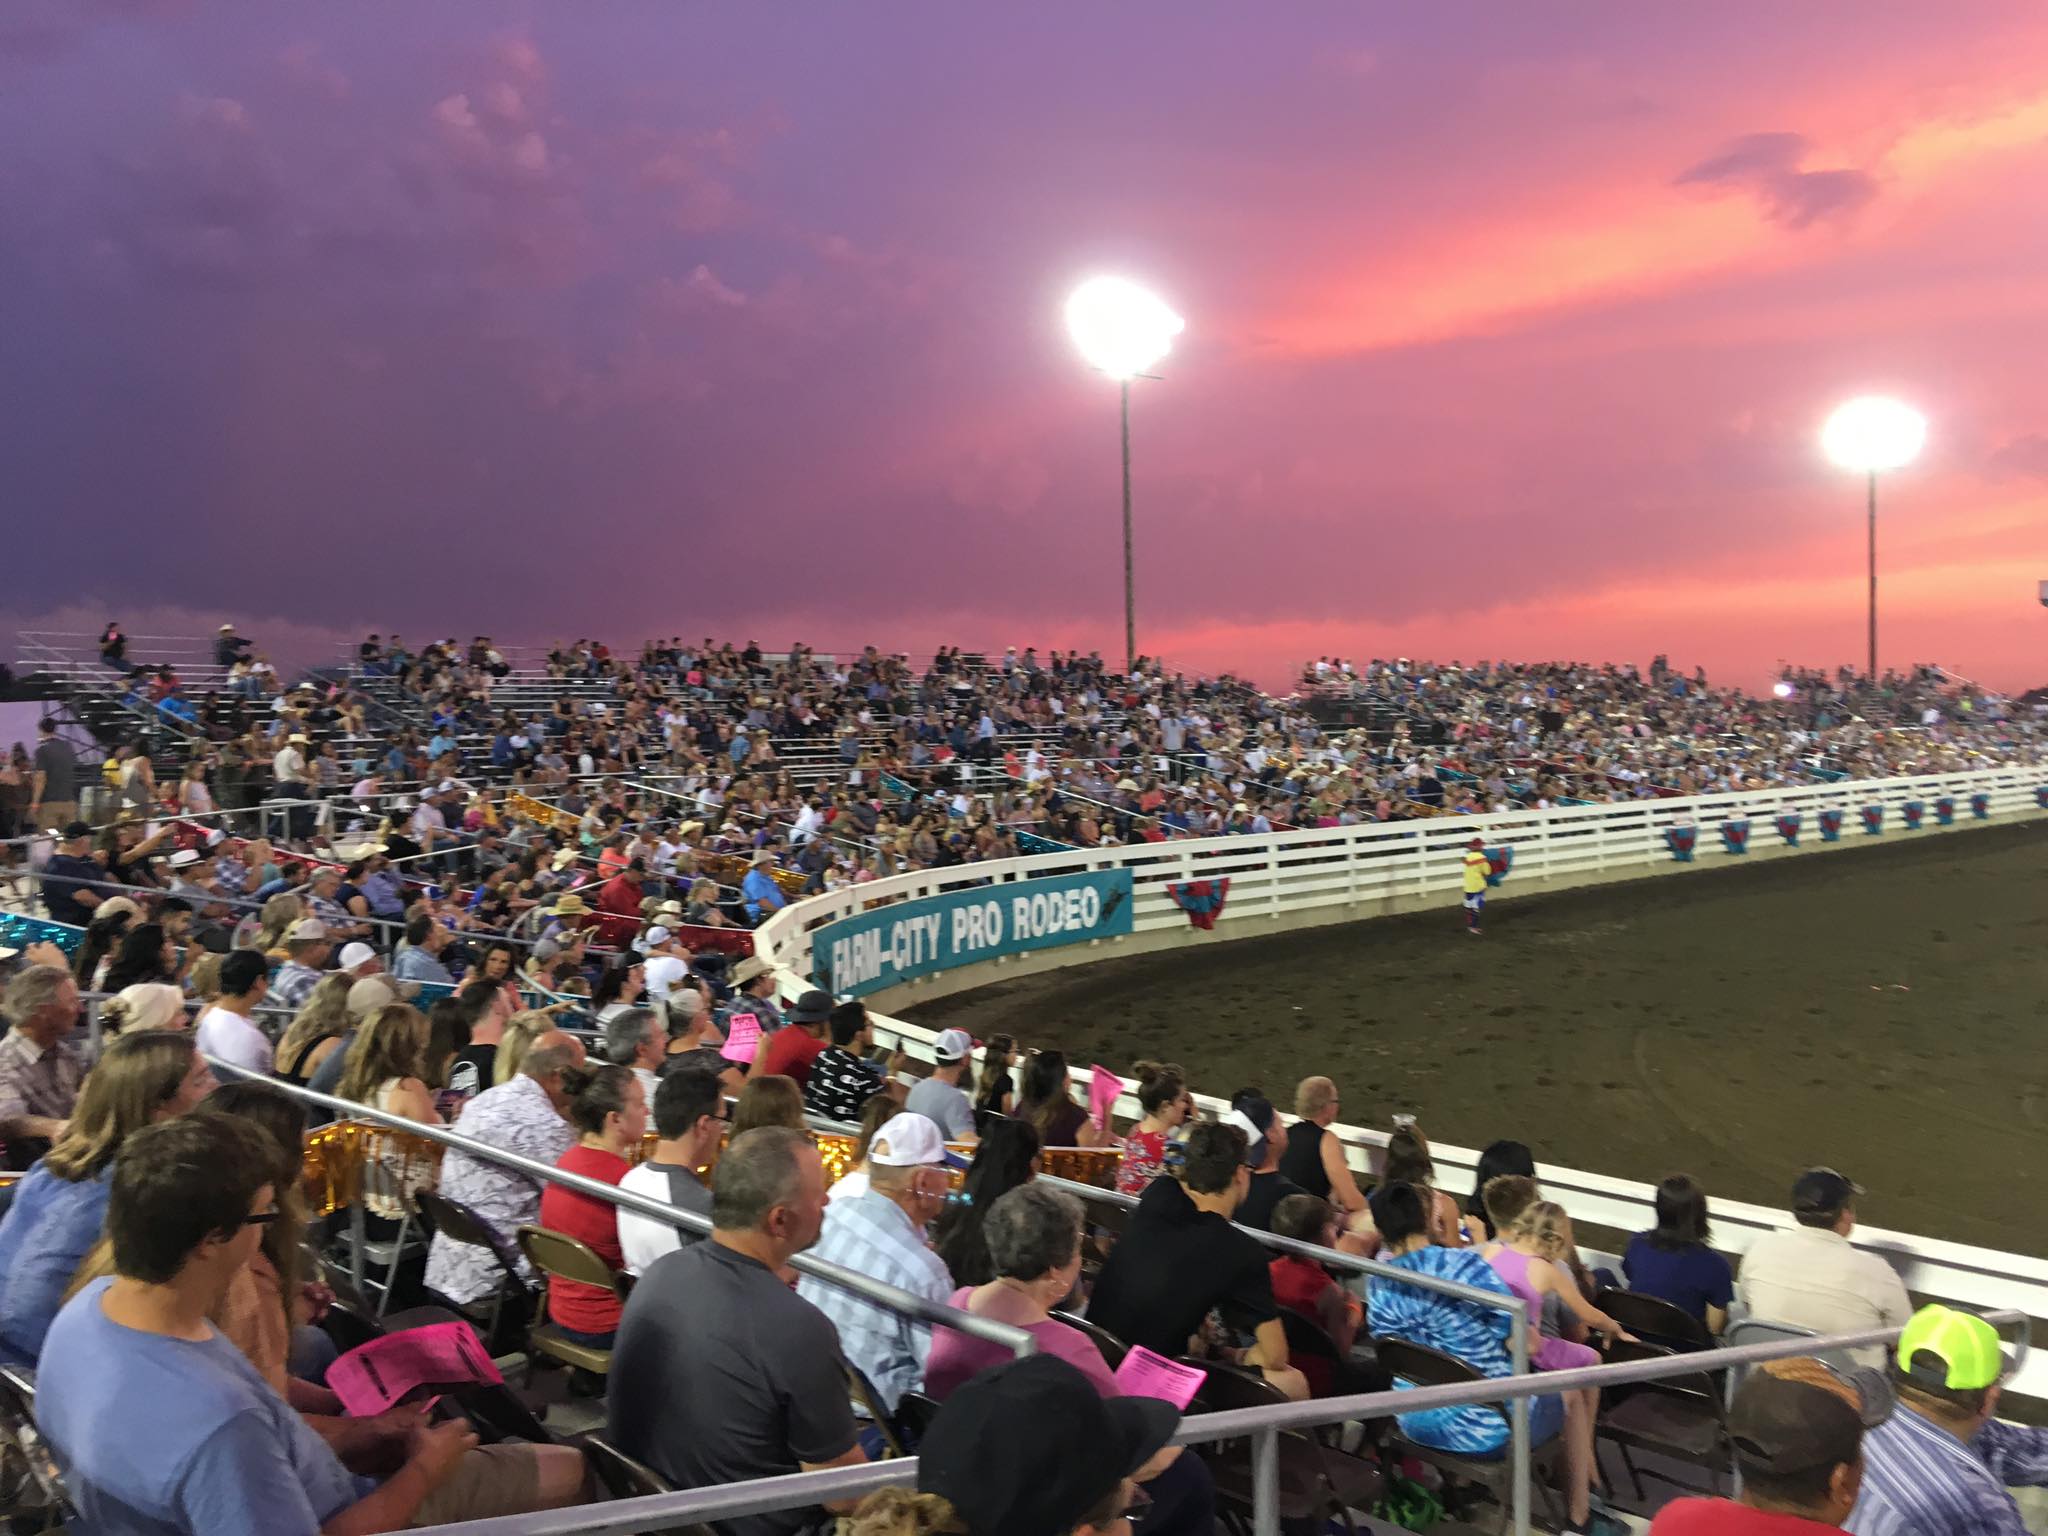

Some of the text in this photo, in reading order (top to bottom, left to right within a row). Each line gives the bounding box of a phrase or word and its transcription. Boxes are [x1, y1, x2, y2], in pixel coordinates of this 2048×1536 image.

[832, 885, 1100, 995] FARM-CITY PRO RODEO
